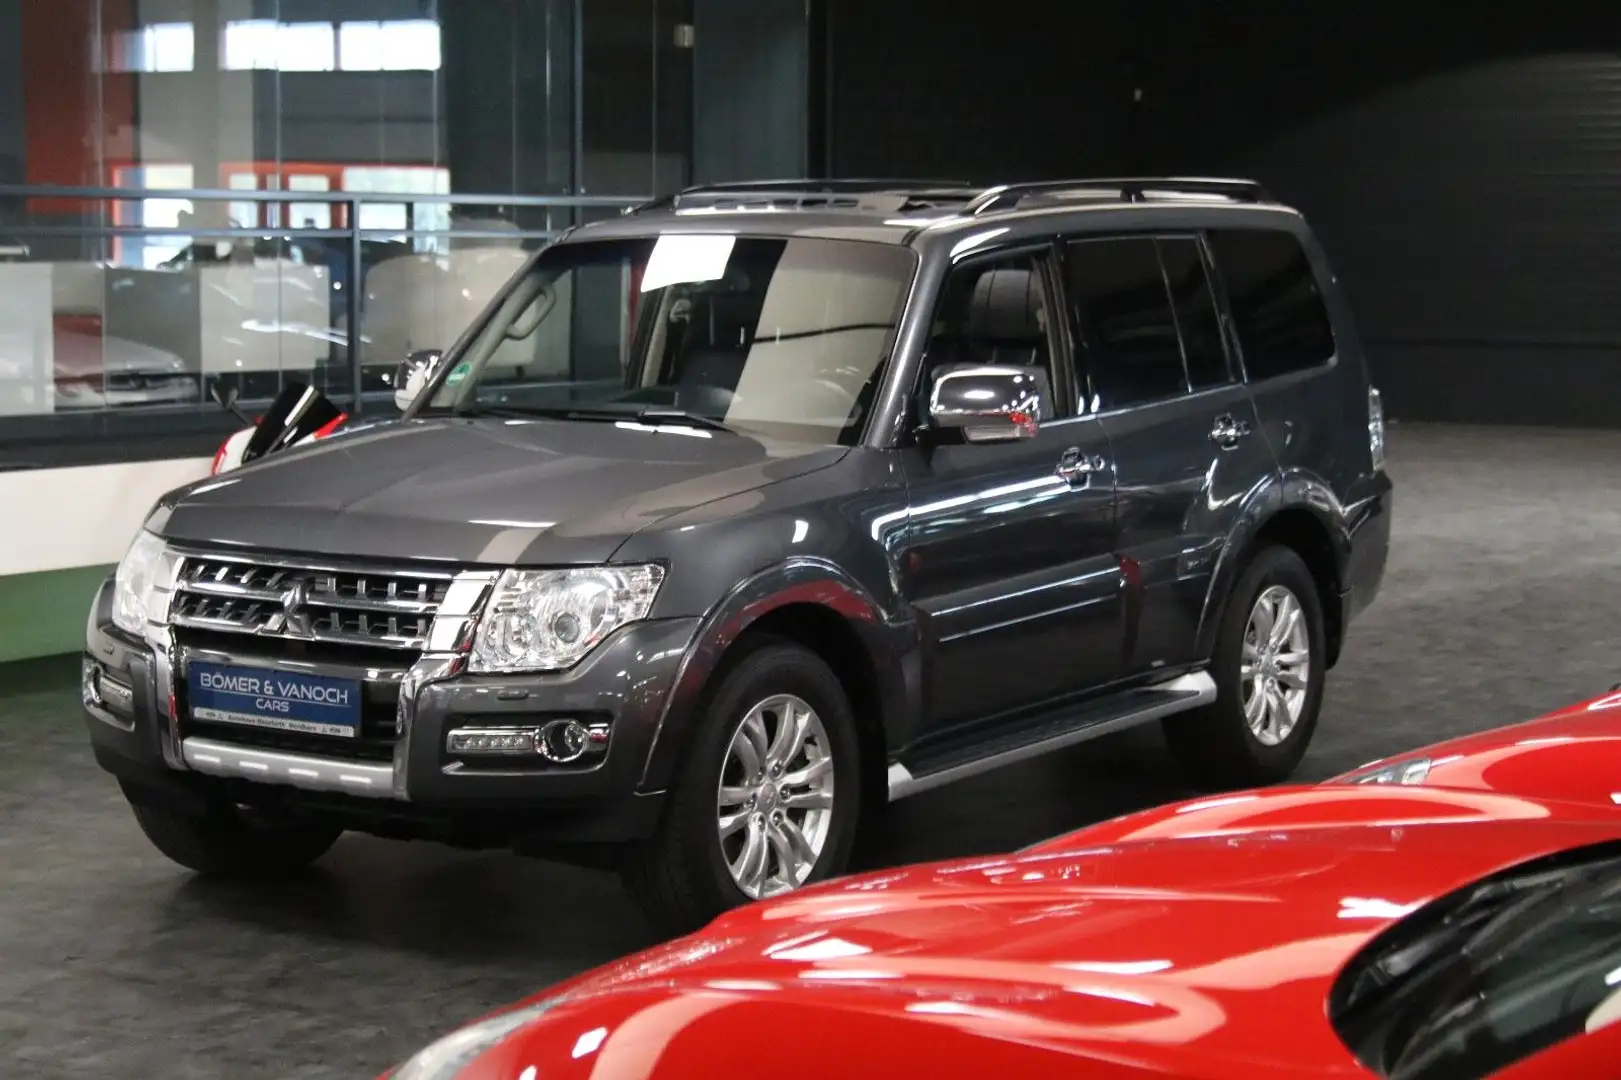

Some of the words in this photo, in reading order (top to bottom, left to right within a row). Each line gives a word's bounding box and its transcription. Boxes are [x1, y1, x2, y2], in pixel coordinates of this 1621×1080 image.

[200, 672, 259, 693] BÖMER
[264, 681, 274, 695] &
[278, 682, 348, 704] VANOCH
[256, 699, 289, 712] CARS
